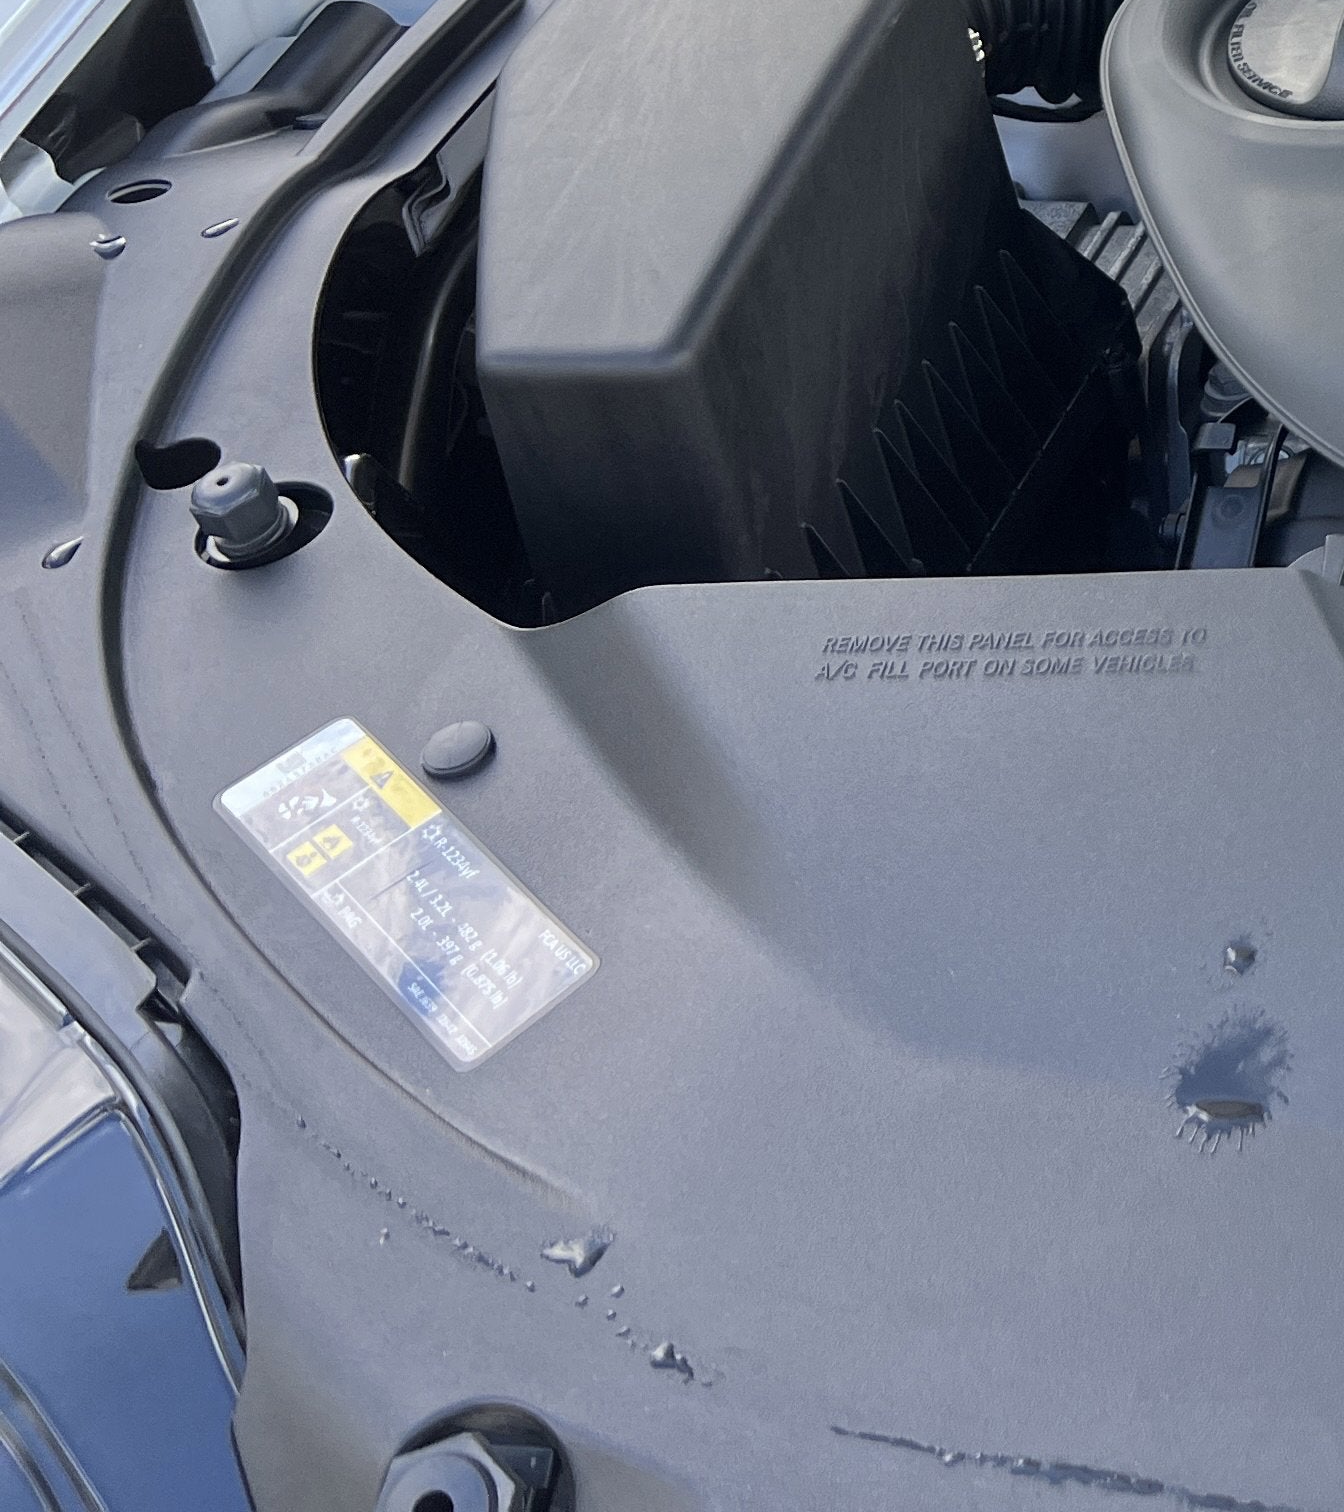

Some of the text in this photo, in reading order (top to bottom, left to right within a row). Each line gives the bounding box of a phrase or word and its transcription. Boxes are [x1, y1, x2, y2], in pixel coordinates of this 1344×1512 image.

[1229, 22, 1245, 64] FILTER
[1236, 61, 1293, 99] SERVICE
[822, 627, 1208, 654] REMOVE THIS PANEL FOR ACCESS TO
[815, 653, 1195, 680] A/C FILL PORT ON SOME VEHICLES
[434, 837, 479, 879] R-1234yf
[430, 894, 453, 917] 3.2L
[436, 935, 460, 956] 397
[538, 929, 586, 976] FCA US LLC
